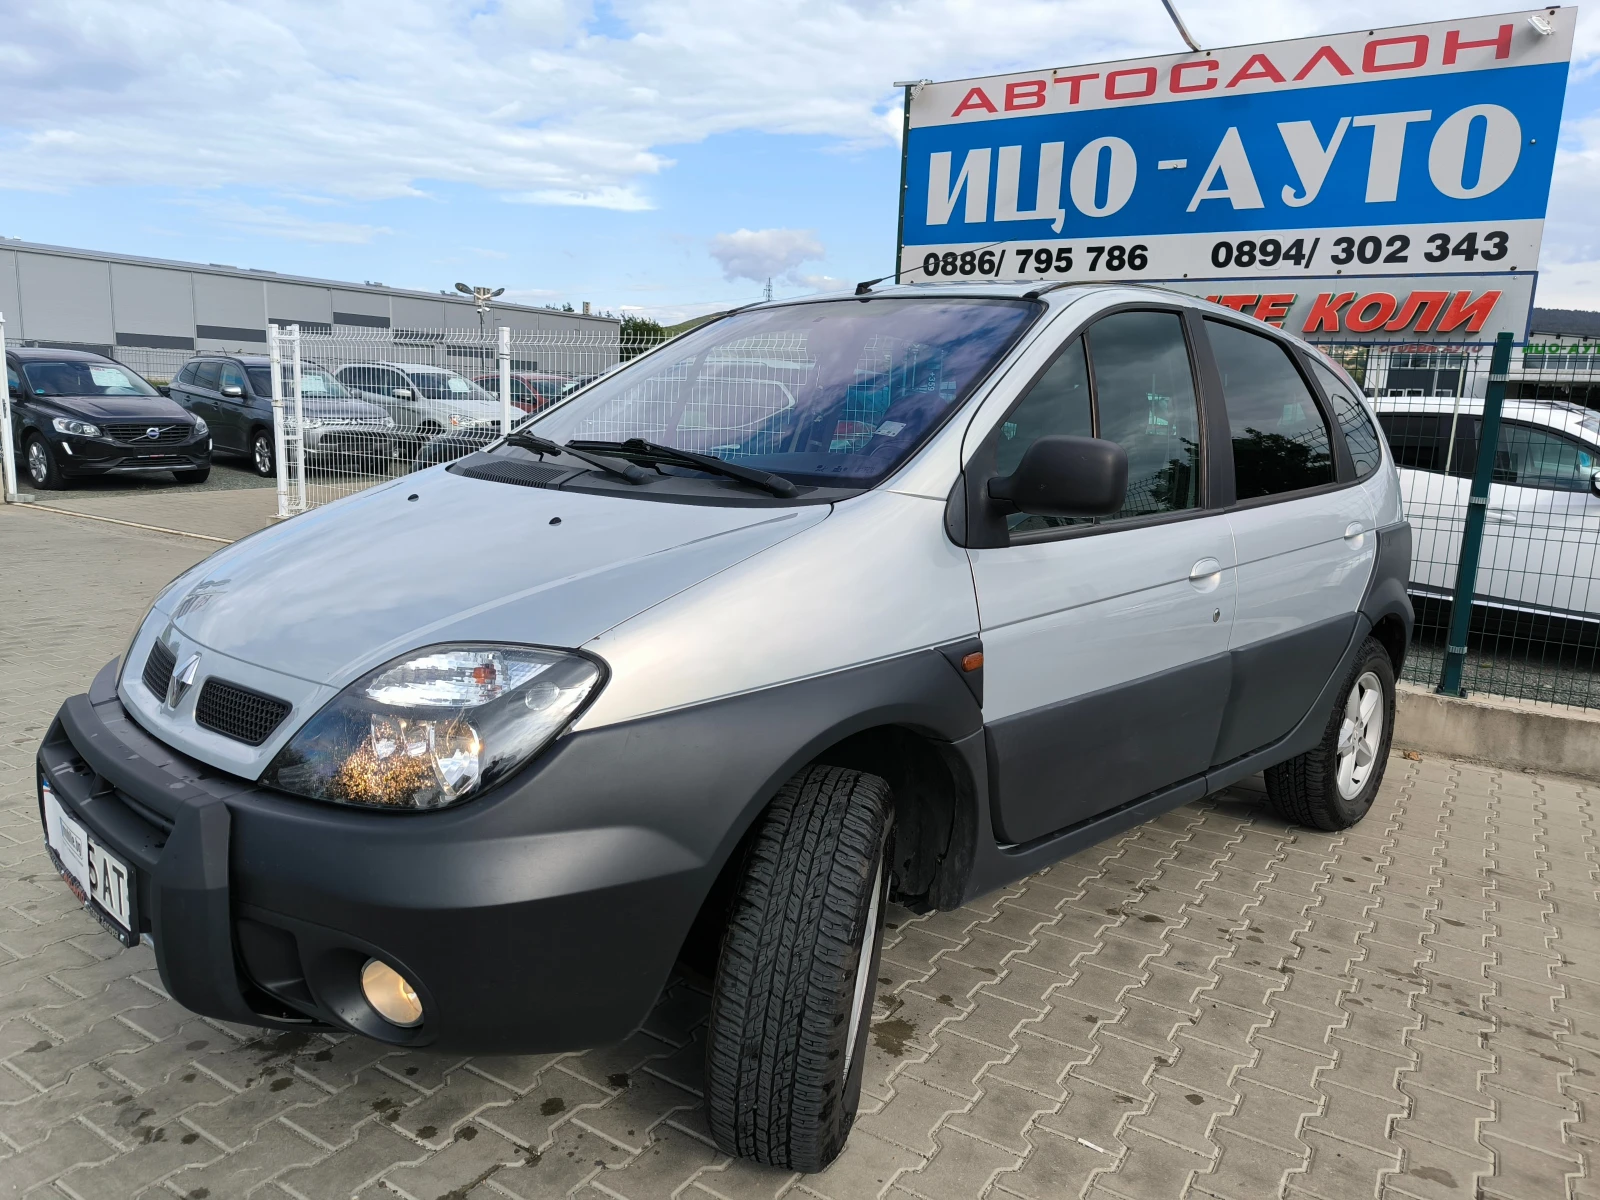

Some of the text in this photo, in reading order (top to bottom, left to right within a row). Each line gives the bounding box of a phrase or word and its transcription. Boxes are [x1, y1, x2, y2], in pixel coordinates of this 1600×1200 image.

[950, 24, 1514, 118] АВТОСАЛОН
[923, 244, 1149, 277] 0886/ 795 786
[1210, 231, 1509, 269] 0894/ 302 343
[1205, 289, 1504, 334] ТЕ КОЛИ
[1522, 343, 1600, 354] ИЦО-АУ
